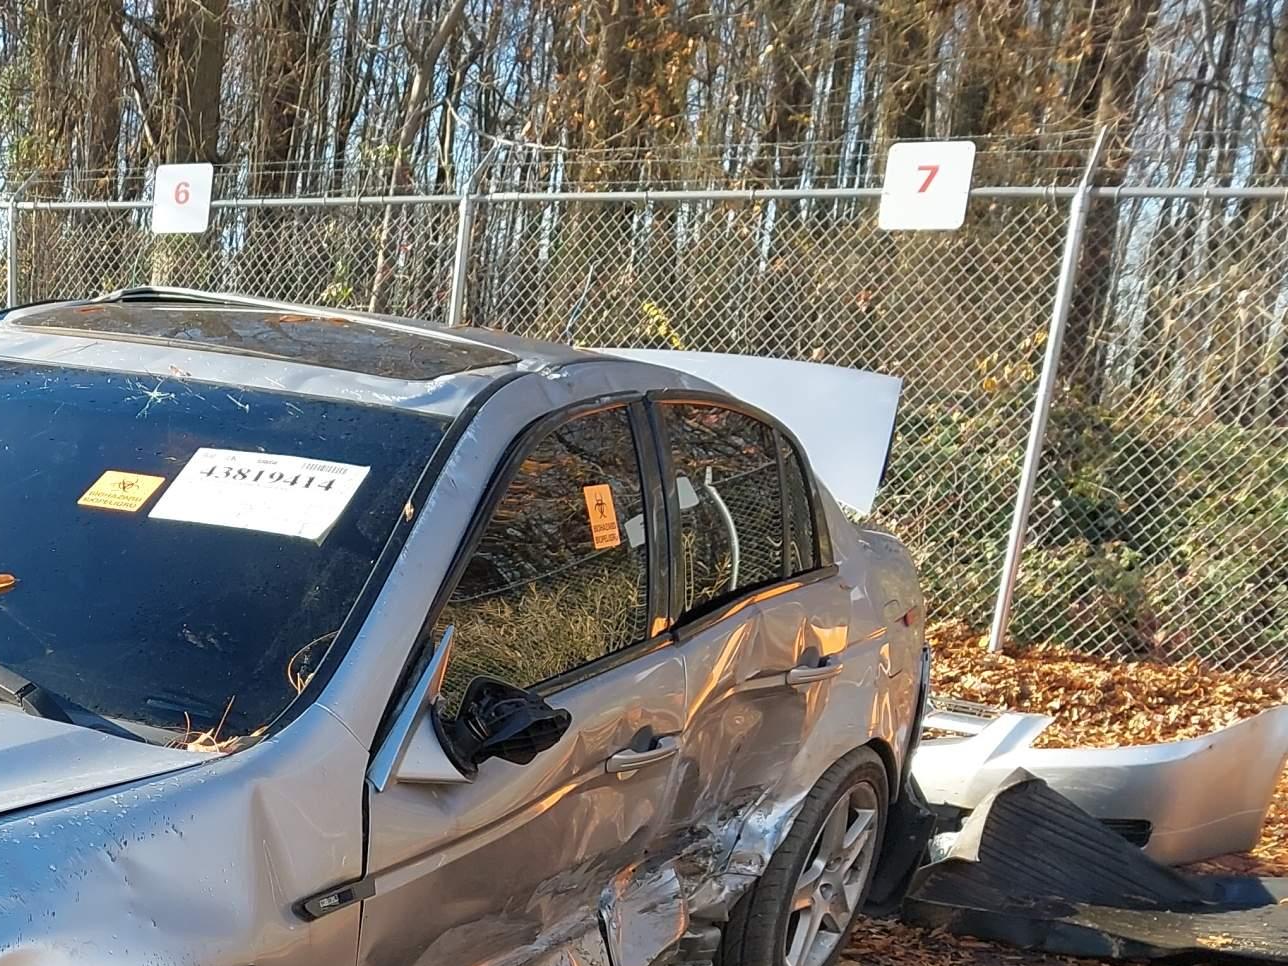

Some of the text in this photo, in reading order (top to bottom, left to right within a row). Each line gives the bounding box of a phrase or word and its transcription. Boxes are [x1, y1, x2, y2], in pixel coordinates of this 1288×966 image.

[918, 165, 940, 193] 7
[174, 181, 191, 205] 6
[199, 465, 336, 492] 43819414
